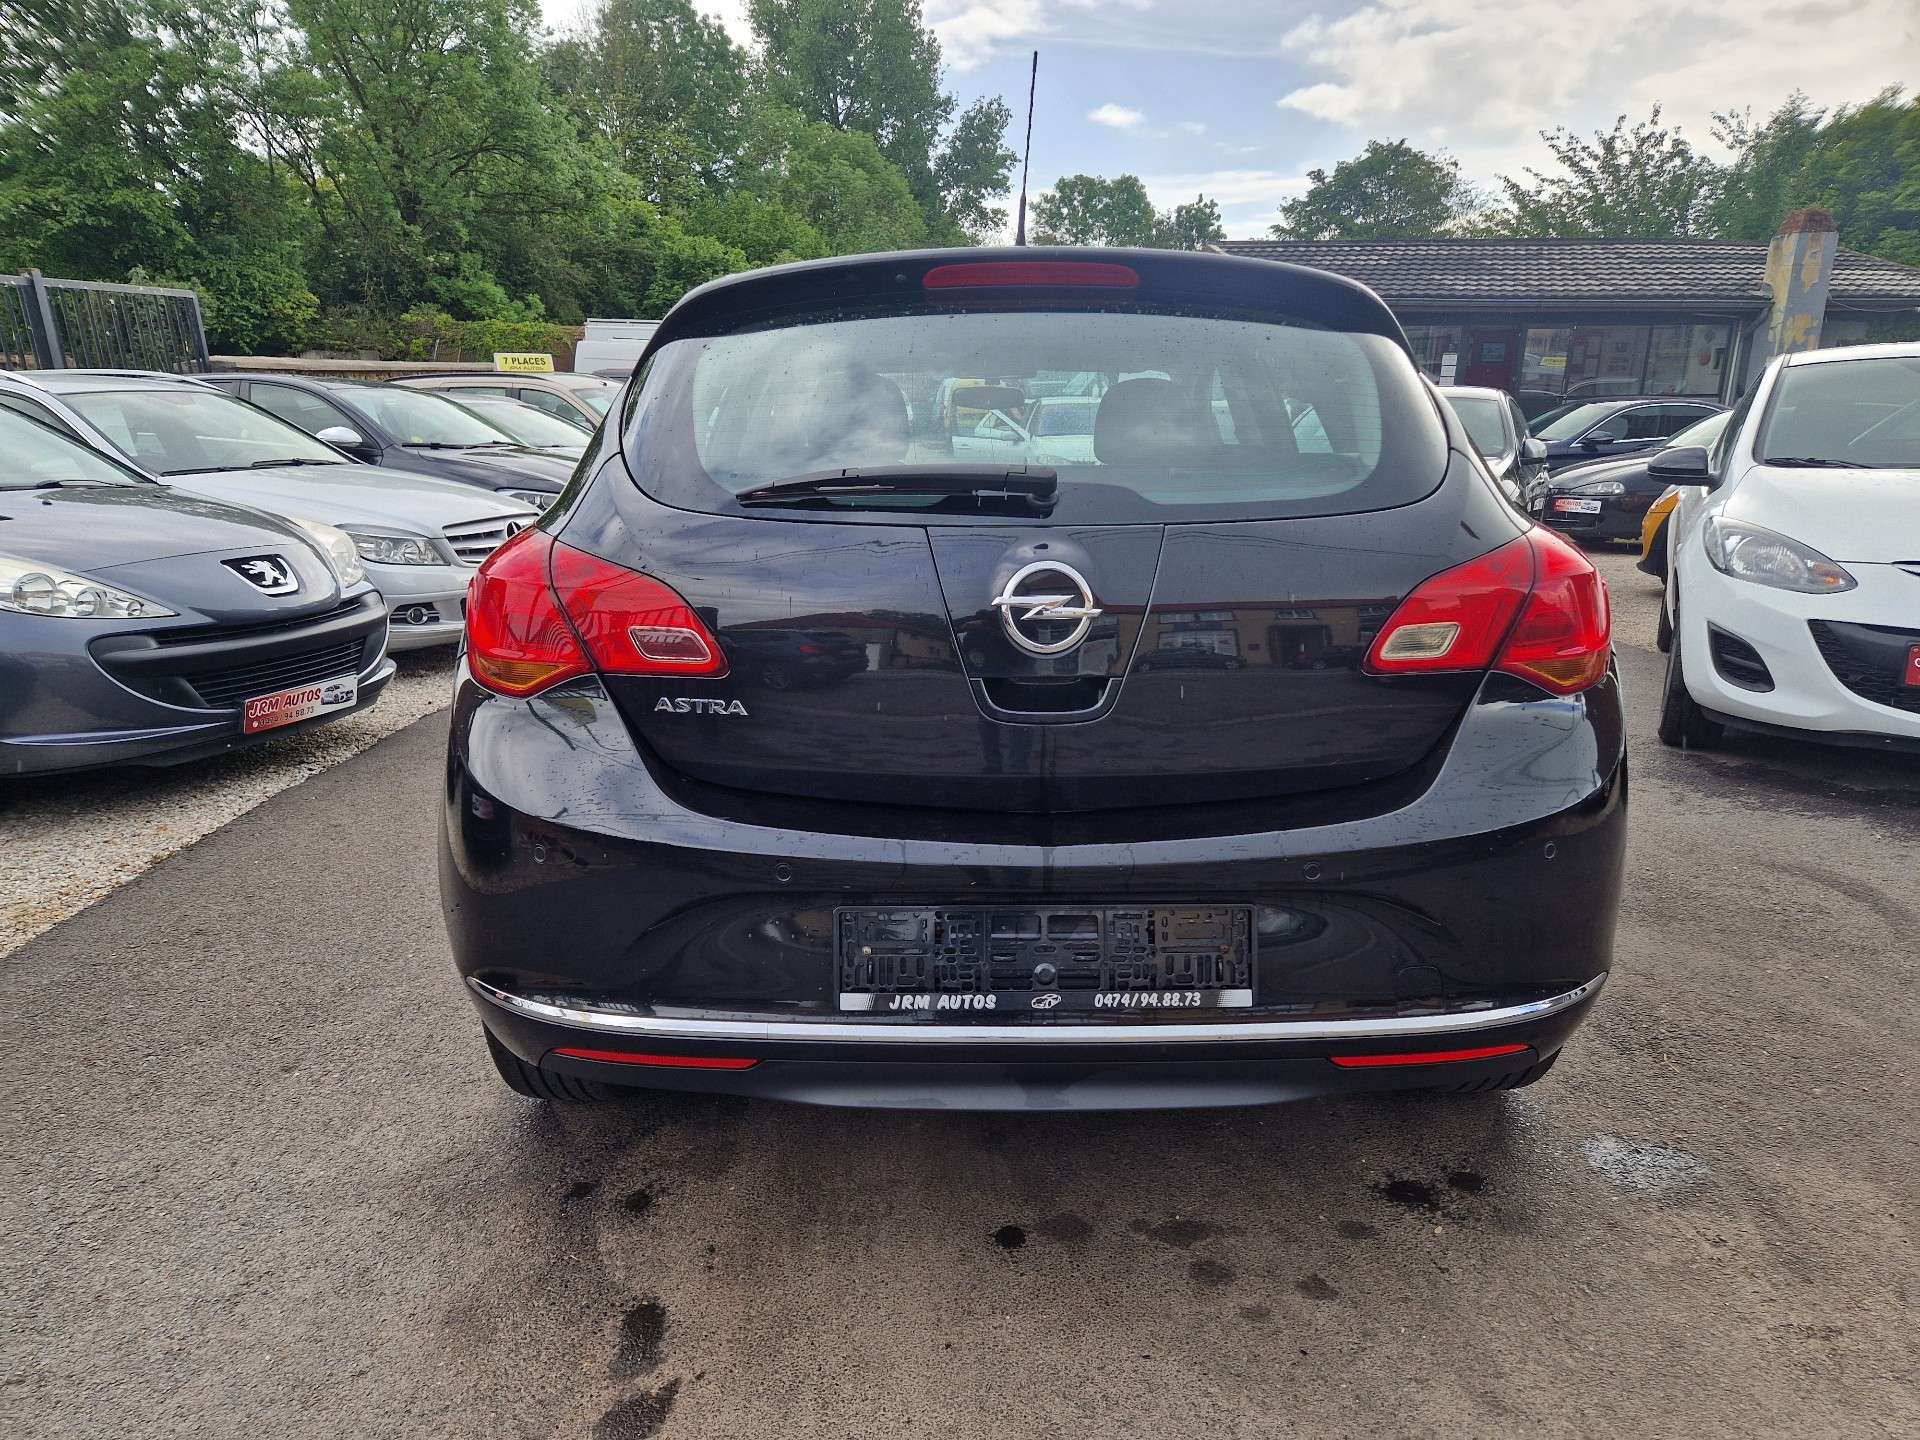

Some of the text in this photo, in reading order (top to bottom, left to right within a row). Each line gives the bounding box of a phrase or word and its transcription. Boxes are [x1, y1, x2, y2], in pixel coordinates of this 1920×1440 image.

[502, 356, 546, 366] 7 PLACES
[248, 688, 322, 718] JRM AUTOS
[654, 697, 748, 715] ASTRA
[889, 994, 997, 1010] JRM AUTOS
[1094, 992, 1201, 1008] 0474/94.88.73
